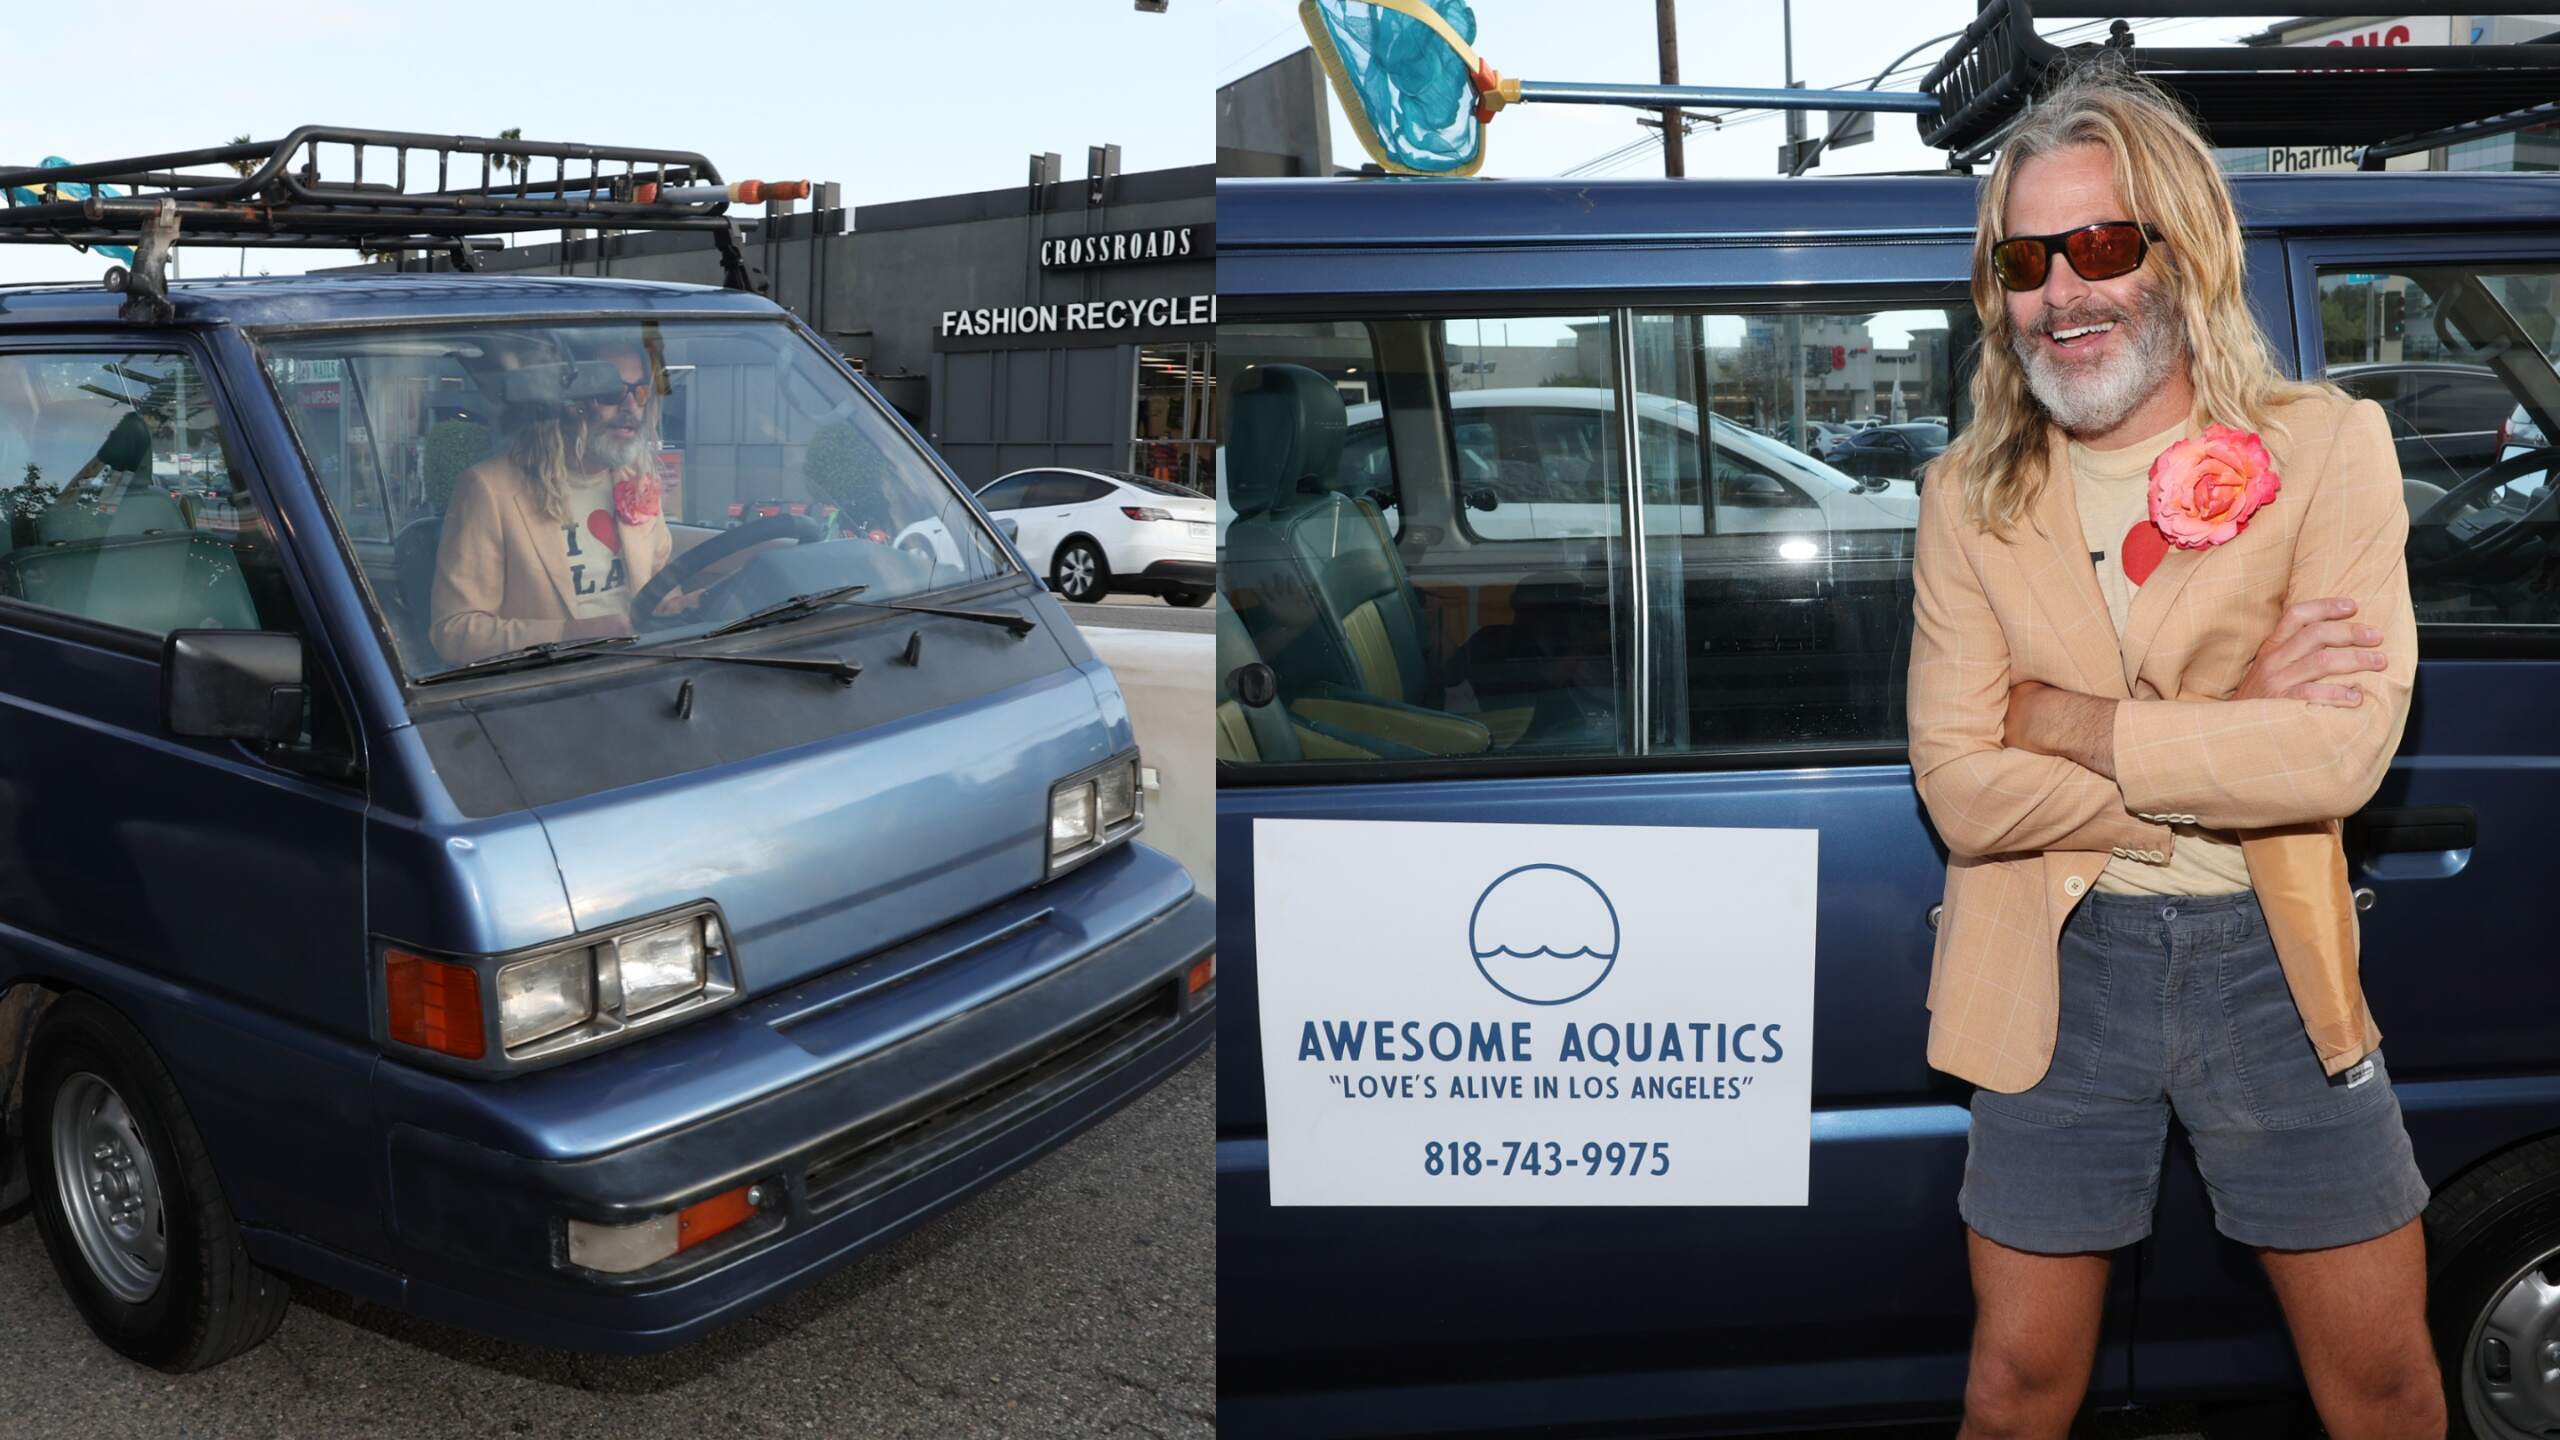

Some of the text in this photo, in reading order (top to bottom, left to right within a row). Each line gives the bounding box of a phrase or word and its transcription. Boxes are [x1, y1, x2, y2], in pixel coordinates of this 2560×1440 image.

[2272, 146, 2354, 172] Pharma
[1041, 228, 1191, 266] CROSSROADS
[942, 305, 1057, 337] FASHION
[561, 522, 583, 556] I
[570, 558, 626, 595] LA
[1297, 1020, 1784, 1067] AWESOME AQUATICS
[1448, 1075, 1524, 1099] ALIVE
[1533, 1075, 1559, 1100] IN
[1569, 1075, 1620, 1100] LOS
[1424, 1140, 1670, 1177] 818-743-9975
